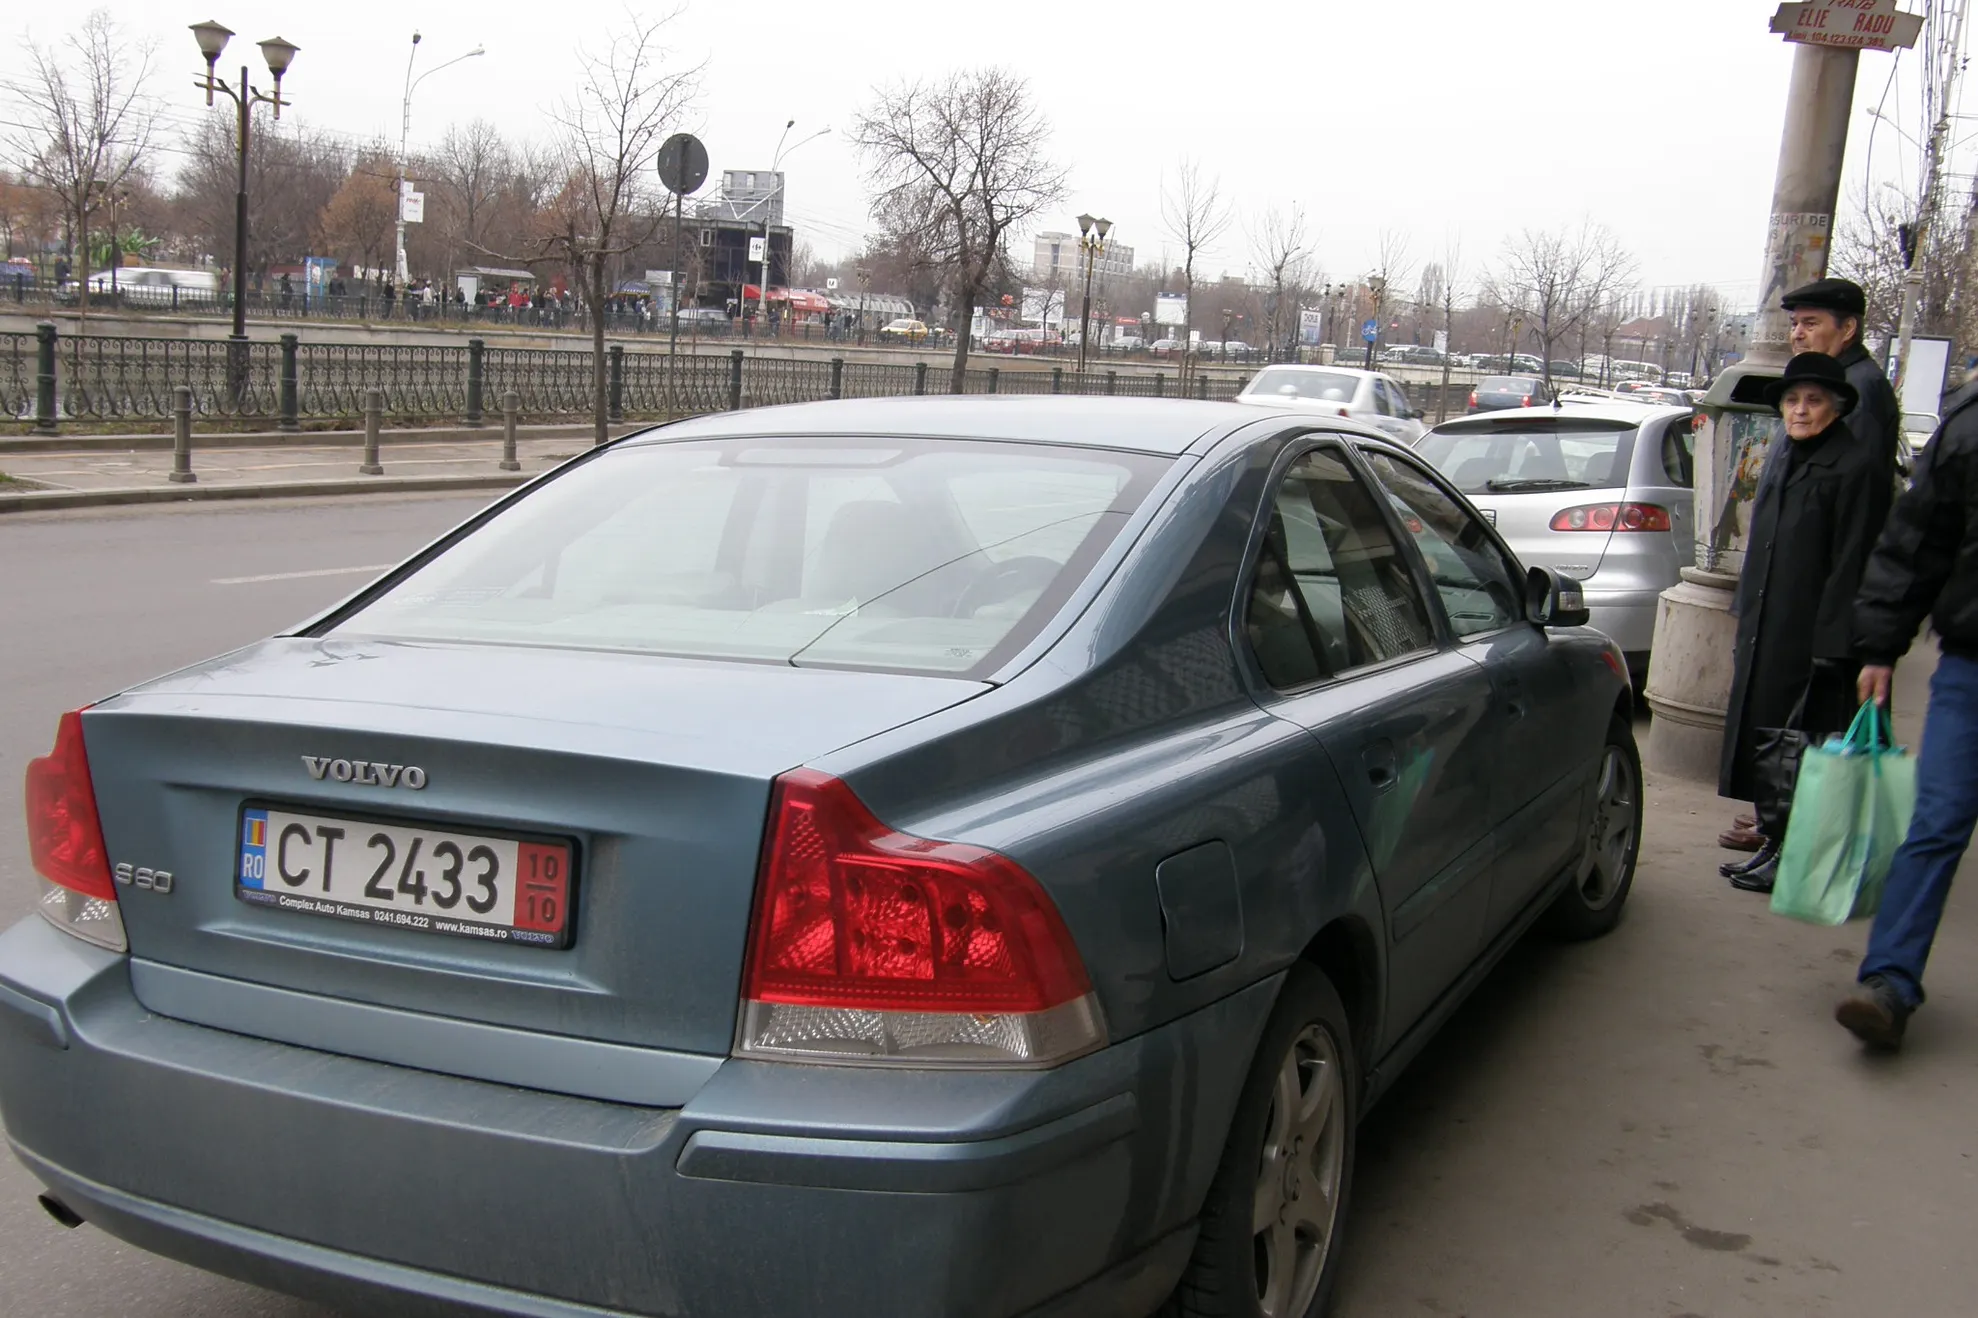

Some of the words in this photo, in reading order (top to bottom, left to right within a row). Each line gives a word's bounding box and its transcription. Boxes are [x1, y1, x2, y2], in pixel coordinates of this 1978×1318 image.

[1797, 8, 1830, 28] ELIE
[1853, 12, 1896, 34] RADU
[1810, 215, 1827, 227] DE
[301, 755, 426, 790] VOLVO
[116, 862, 172, 893] S60
[244, 853, 263, 879] RO
[278, 822, 345, 892] CT
[364, 833, 500, 914] 2433
[529, 853, 559, 880] 10
[279, 895, 314, 911] Complex
[315, 901, 335, 914] Auto
[336, 904, 370, 919] Kamsas
[374, 910, 429, 928] 0241.694.222
[435, 921, 507, 939] www.kamsas.ro
[526, 895, 556, 923] 10
